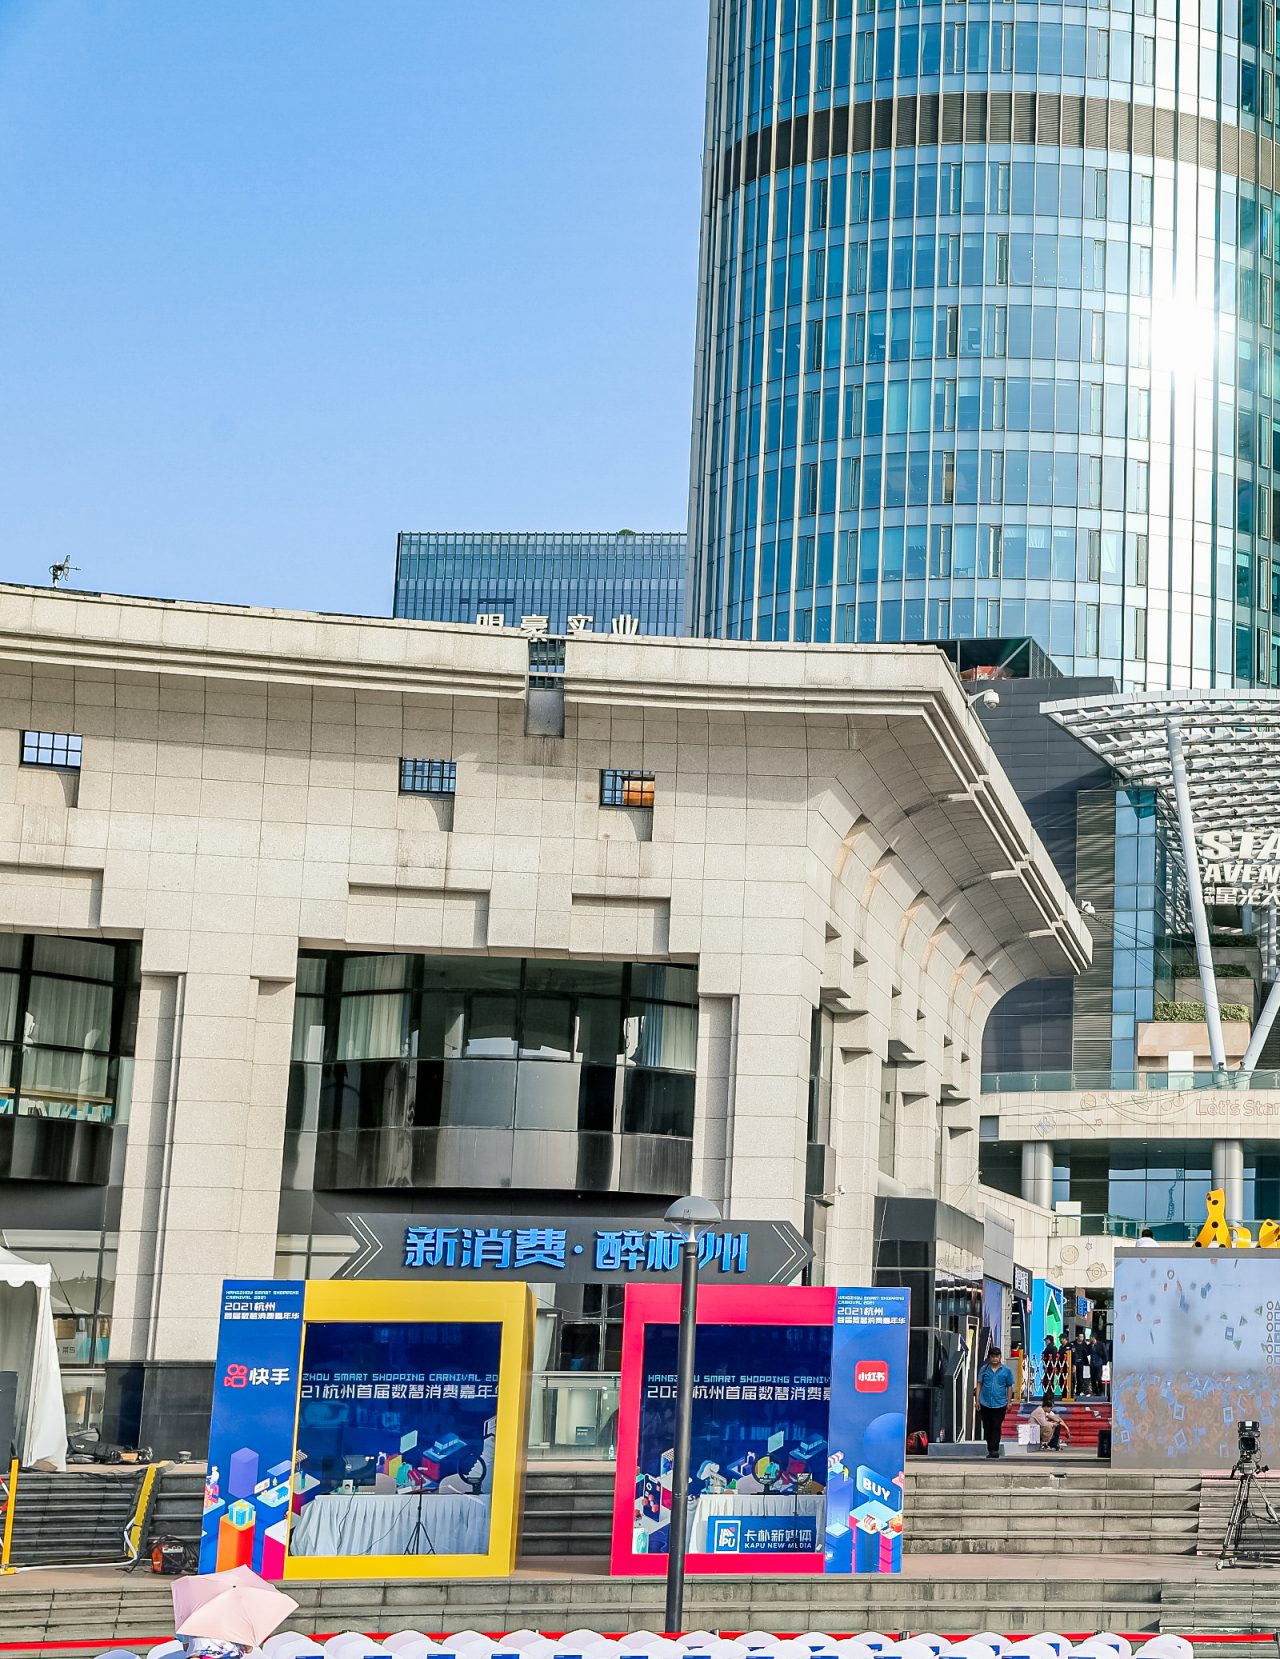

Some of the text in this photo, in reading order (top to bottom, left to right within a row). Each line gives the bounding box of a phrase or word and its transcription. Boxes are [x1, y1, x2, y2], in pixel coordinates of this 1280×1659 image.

[1195, 1098, 1240, 1116] Let's
[224, 1302, 276, 1311] 2021杭州
[837, 1307, 883, 1316] 2021杭州
[249, 1367, 290, 1386] 快手
[333, 1373, 368, 1381] SMART
[372, 1374, 425, 1382] SHOPPING
[429, 1374, 481, 1382] CARNIVAL
[703, 1375, 736, 1383] SMART
[739, 1375, 790, 1384] SHOPPING
[858, 1371, 886, 1382] 小红书
[301, 1384, 499, 1399] 21杭州首届数智消费嘉年
[863, 1477, 890, 1501] BUY
